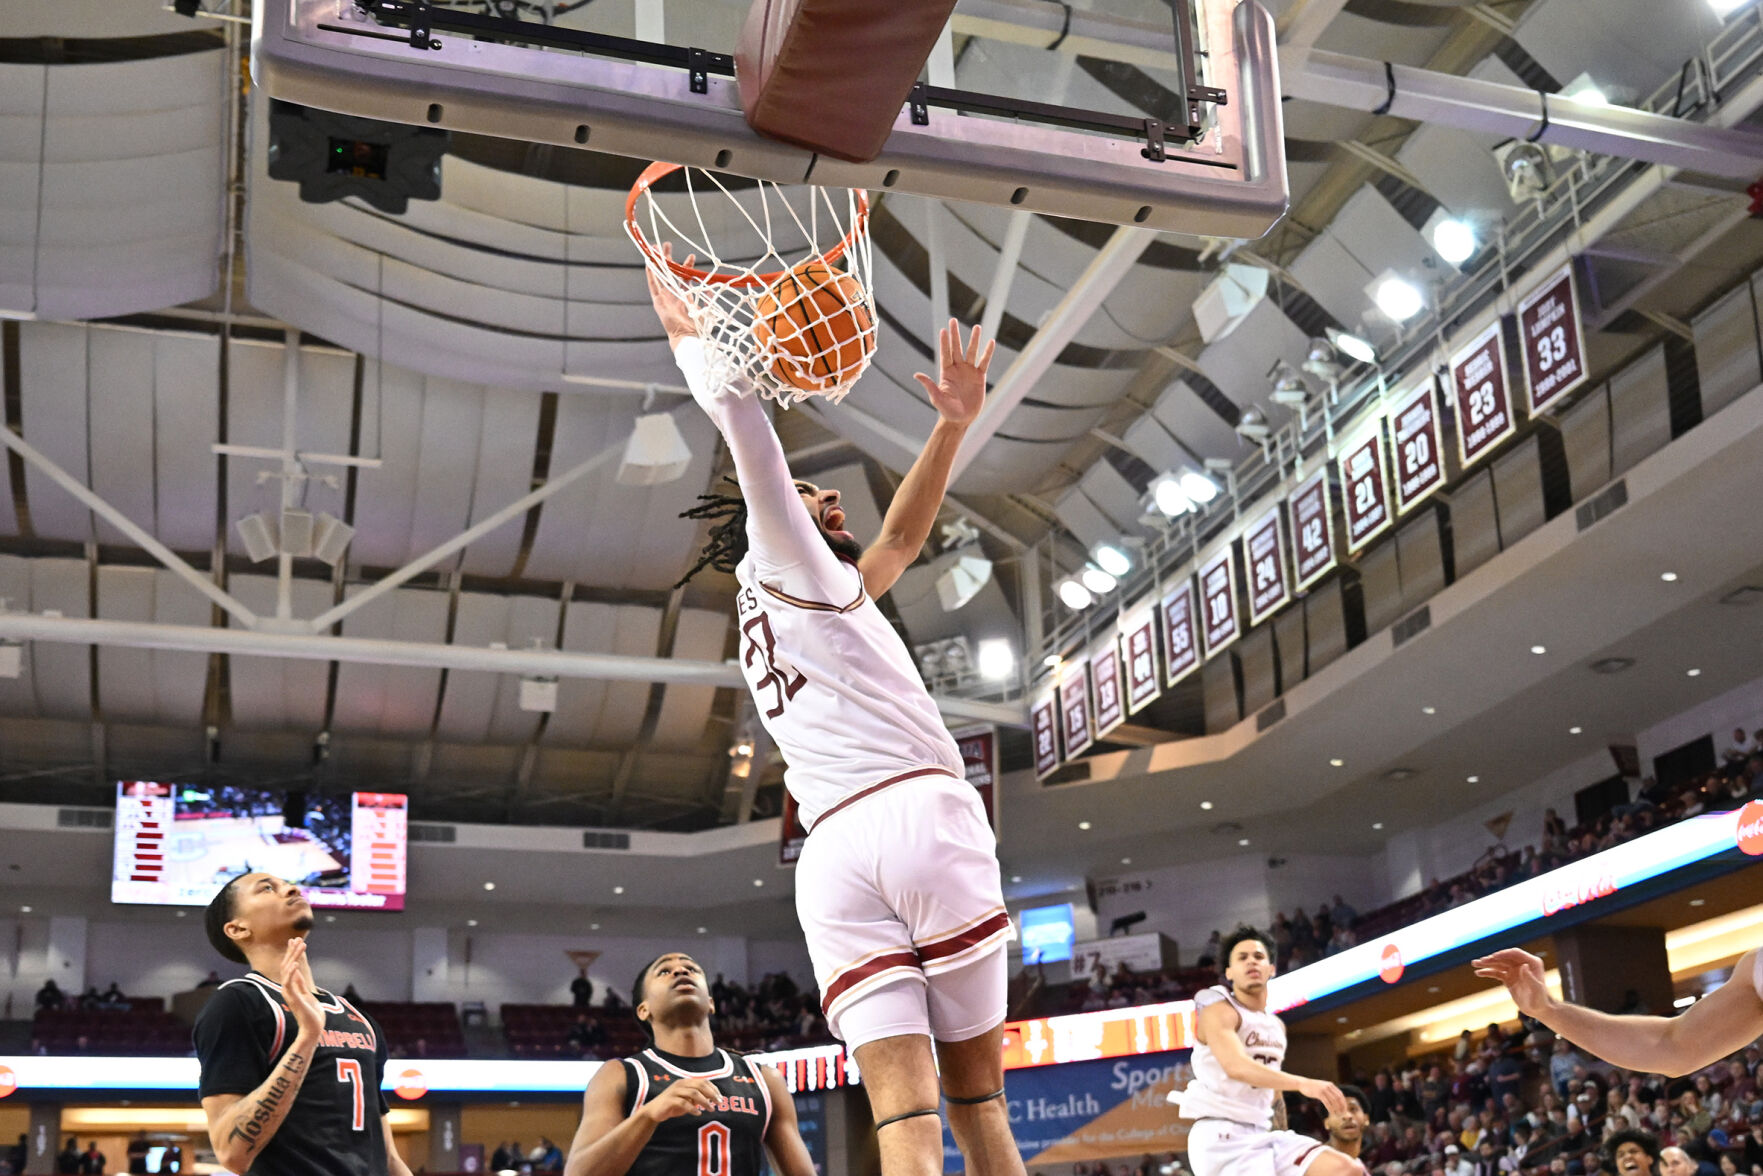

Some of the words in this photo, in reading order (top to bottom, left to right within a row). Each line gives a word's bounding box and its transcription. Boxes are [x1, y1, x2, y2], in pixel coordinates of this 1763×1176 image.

[1537, 326, 1567, 371] 33
[1469, 381, 1495, 425] 23
[1404, 432, 1430, 474] 20
[1355, 476, 1377, 514] 21
[1302, 518, 1323, 552] 42
[1256, 556, 1276, 590] 24
[1210, 592, 1228, 626] 10
[336, 1058, 366, 1131] 7
[1111, 1061, 1194, 1097] Sports
[228, 1076, 291, 1153] Joshua
[1027, 1093, 1100, 1121] Health
[698, 1120, 731, 1176] 0
